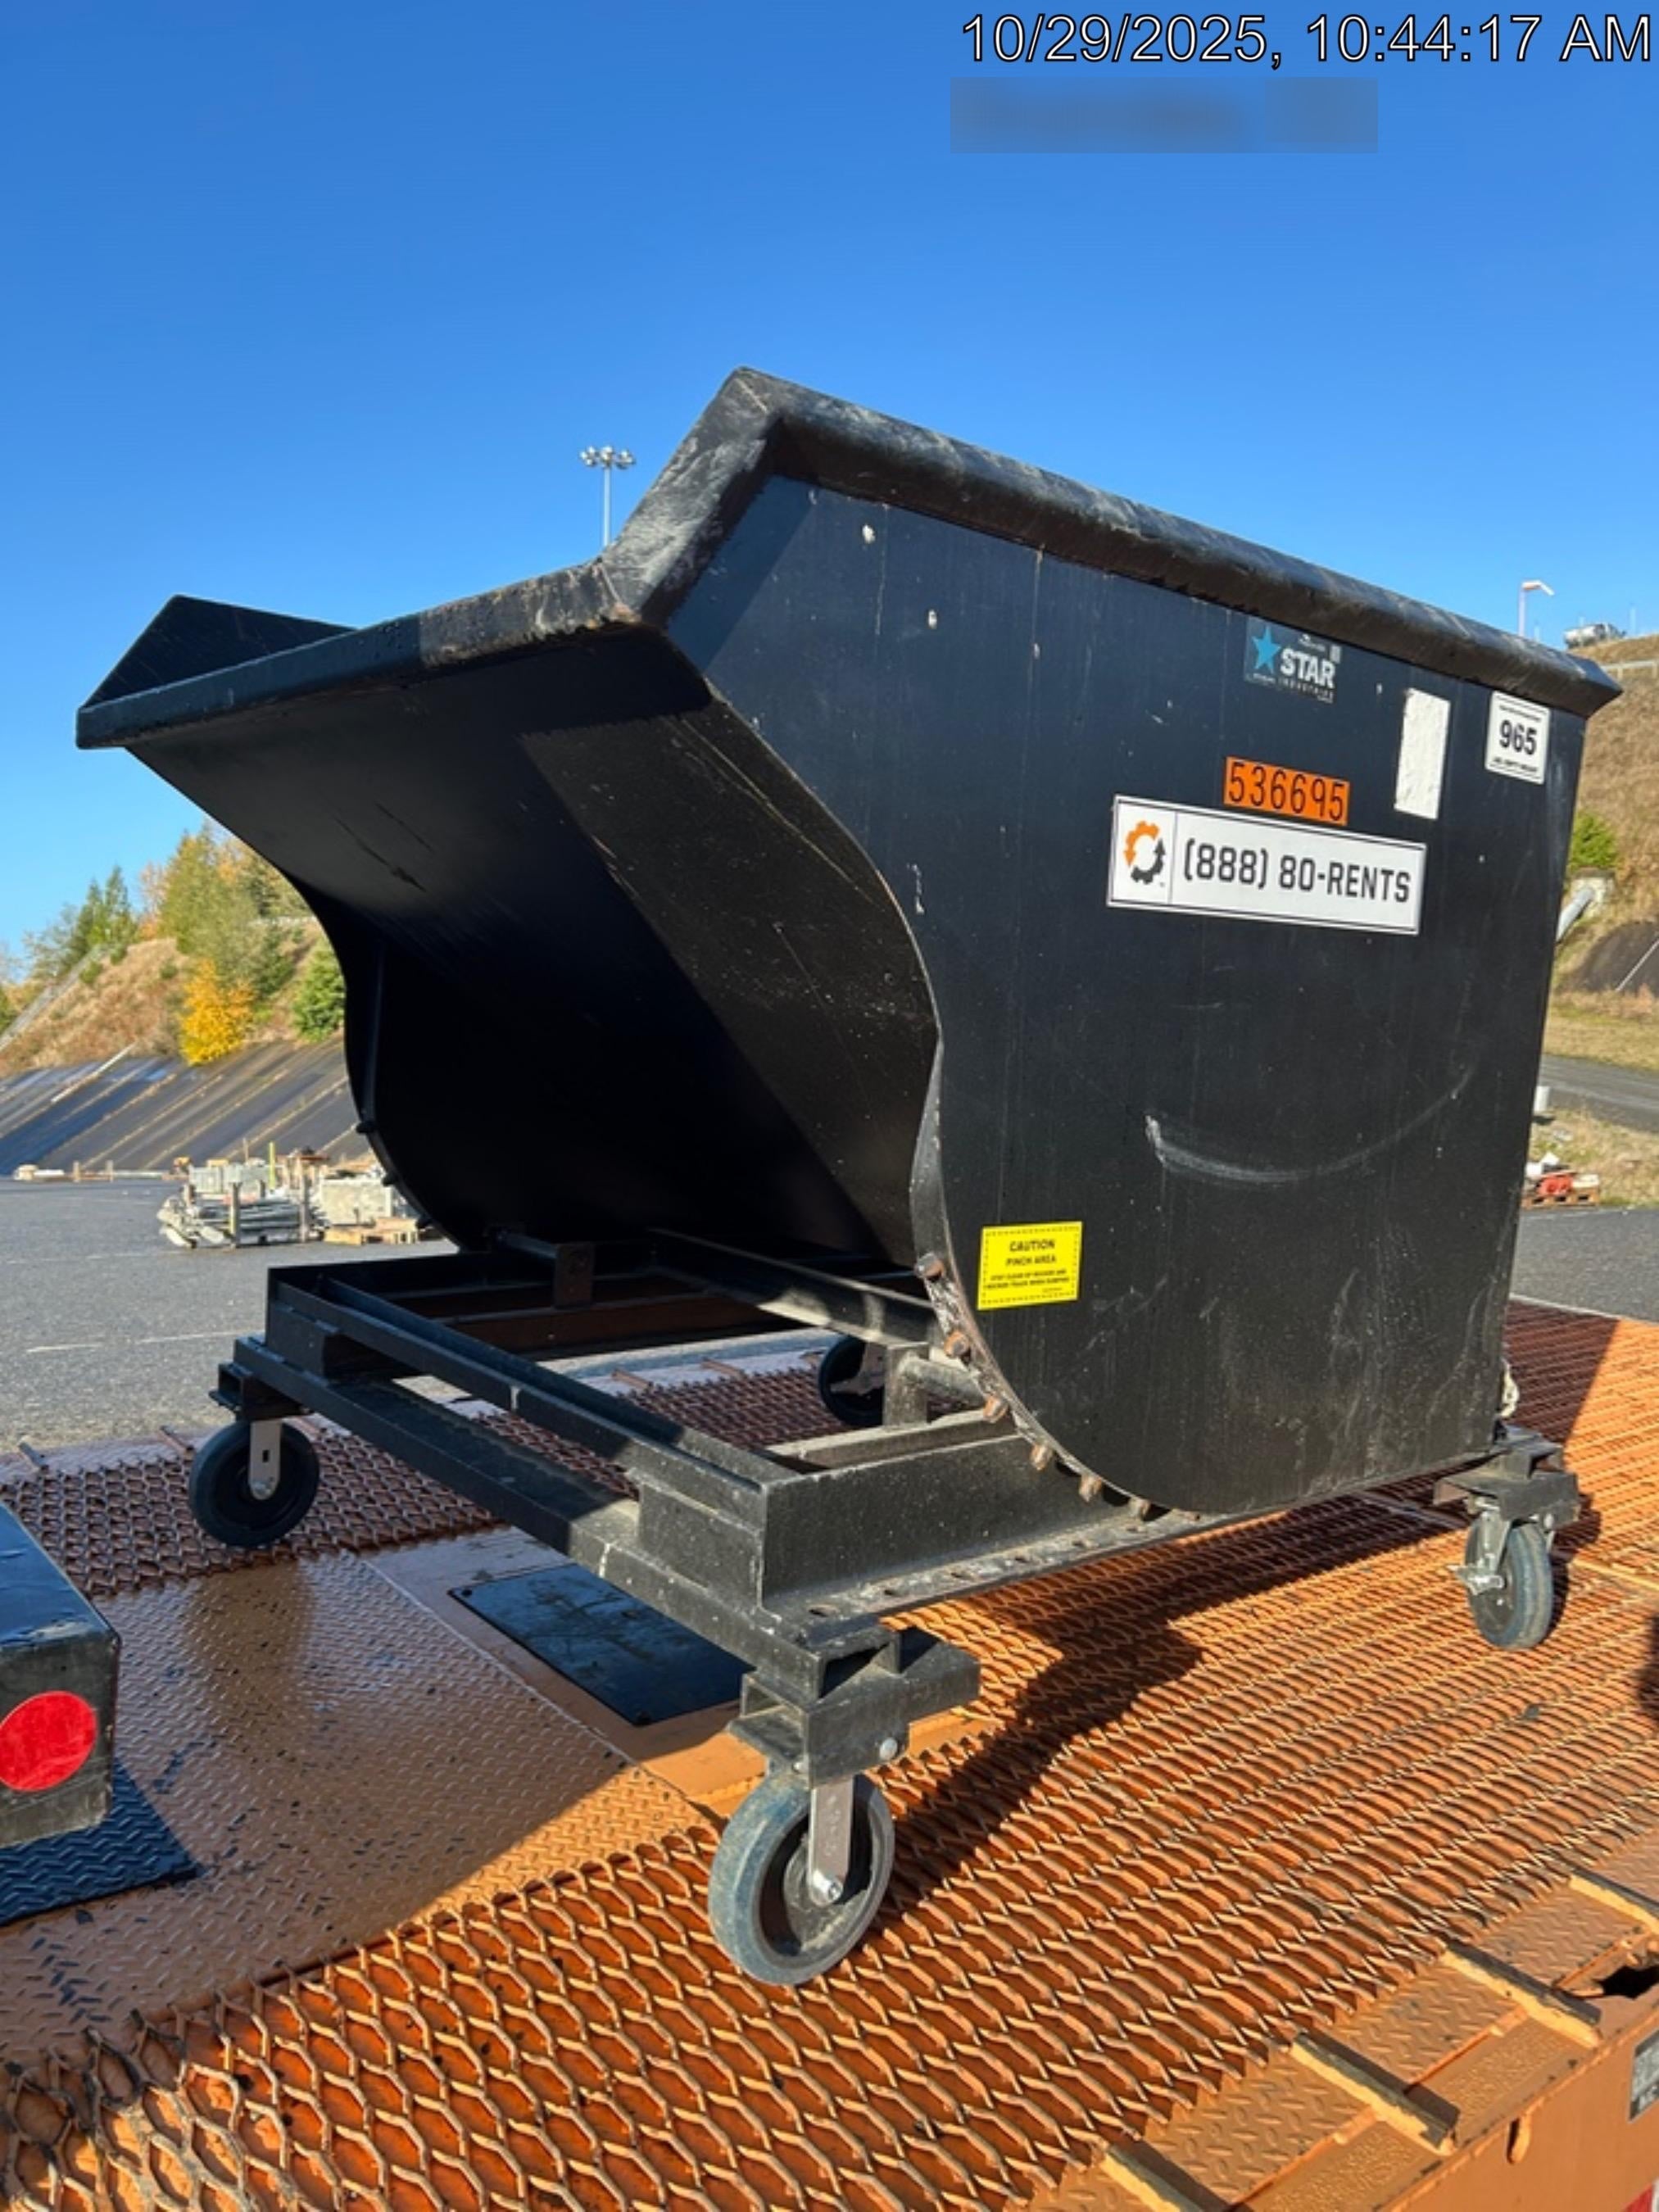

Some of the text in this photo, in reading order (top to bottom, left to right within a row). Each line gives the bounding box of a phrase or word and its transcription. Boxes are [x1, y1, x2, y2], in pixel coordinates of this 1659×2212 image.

[1280, 647, 1335, 689] STAR
[1498, 718, 1538, 755] 965
[1229, 762, 1345, 820] 536695
[1184, 838, 1411, 903] (888) 80-RENTS
[1009, 1240, 1055, 1252] CAUTION
